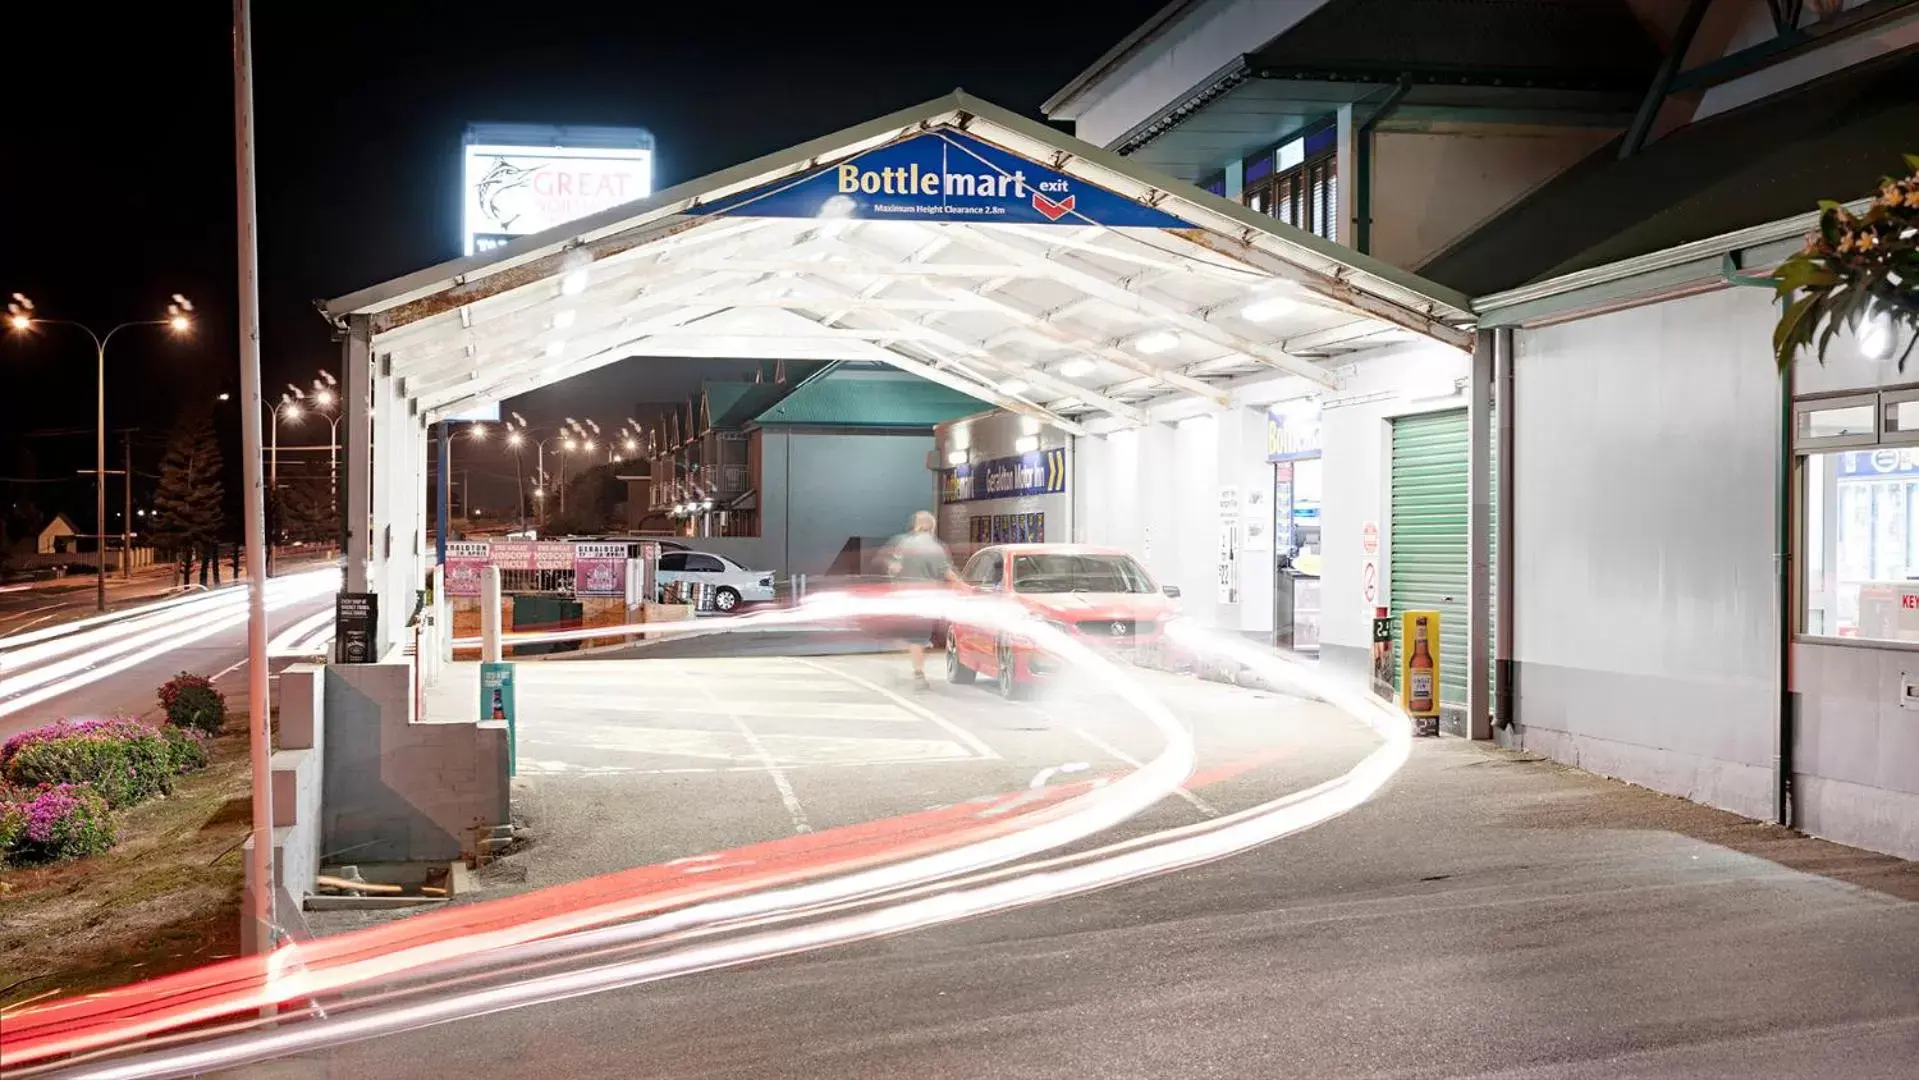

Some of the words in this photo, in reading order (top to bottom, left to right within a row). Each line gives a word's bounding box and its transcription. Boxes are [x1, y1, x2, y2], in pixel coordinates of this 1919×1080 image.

[533, 171, 632, 197] GREAT
[1039, 179, 1069, 193] exit
[874, 203, 915, 213] Maximum
[916, 204, 944, 214] Height
[945, 204, 984, 214] Clearance
[985, 206, 1005, 215] 2.8m
[490, 552, 531, 560] MOSCOW
